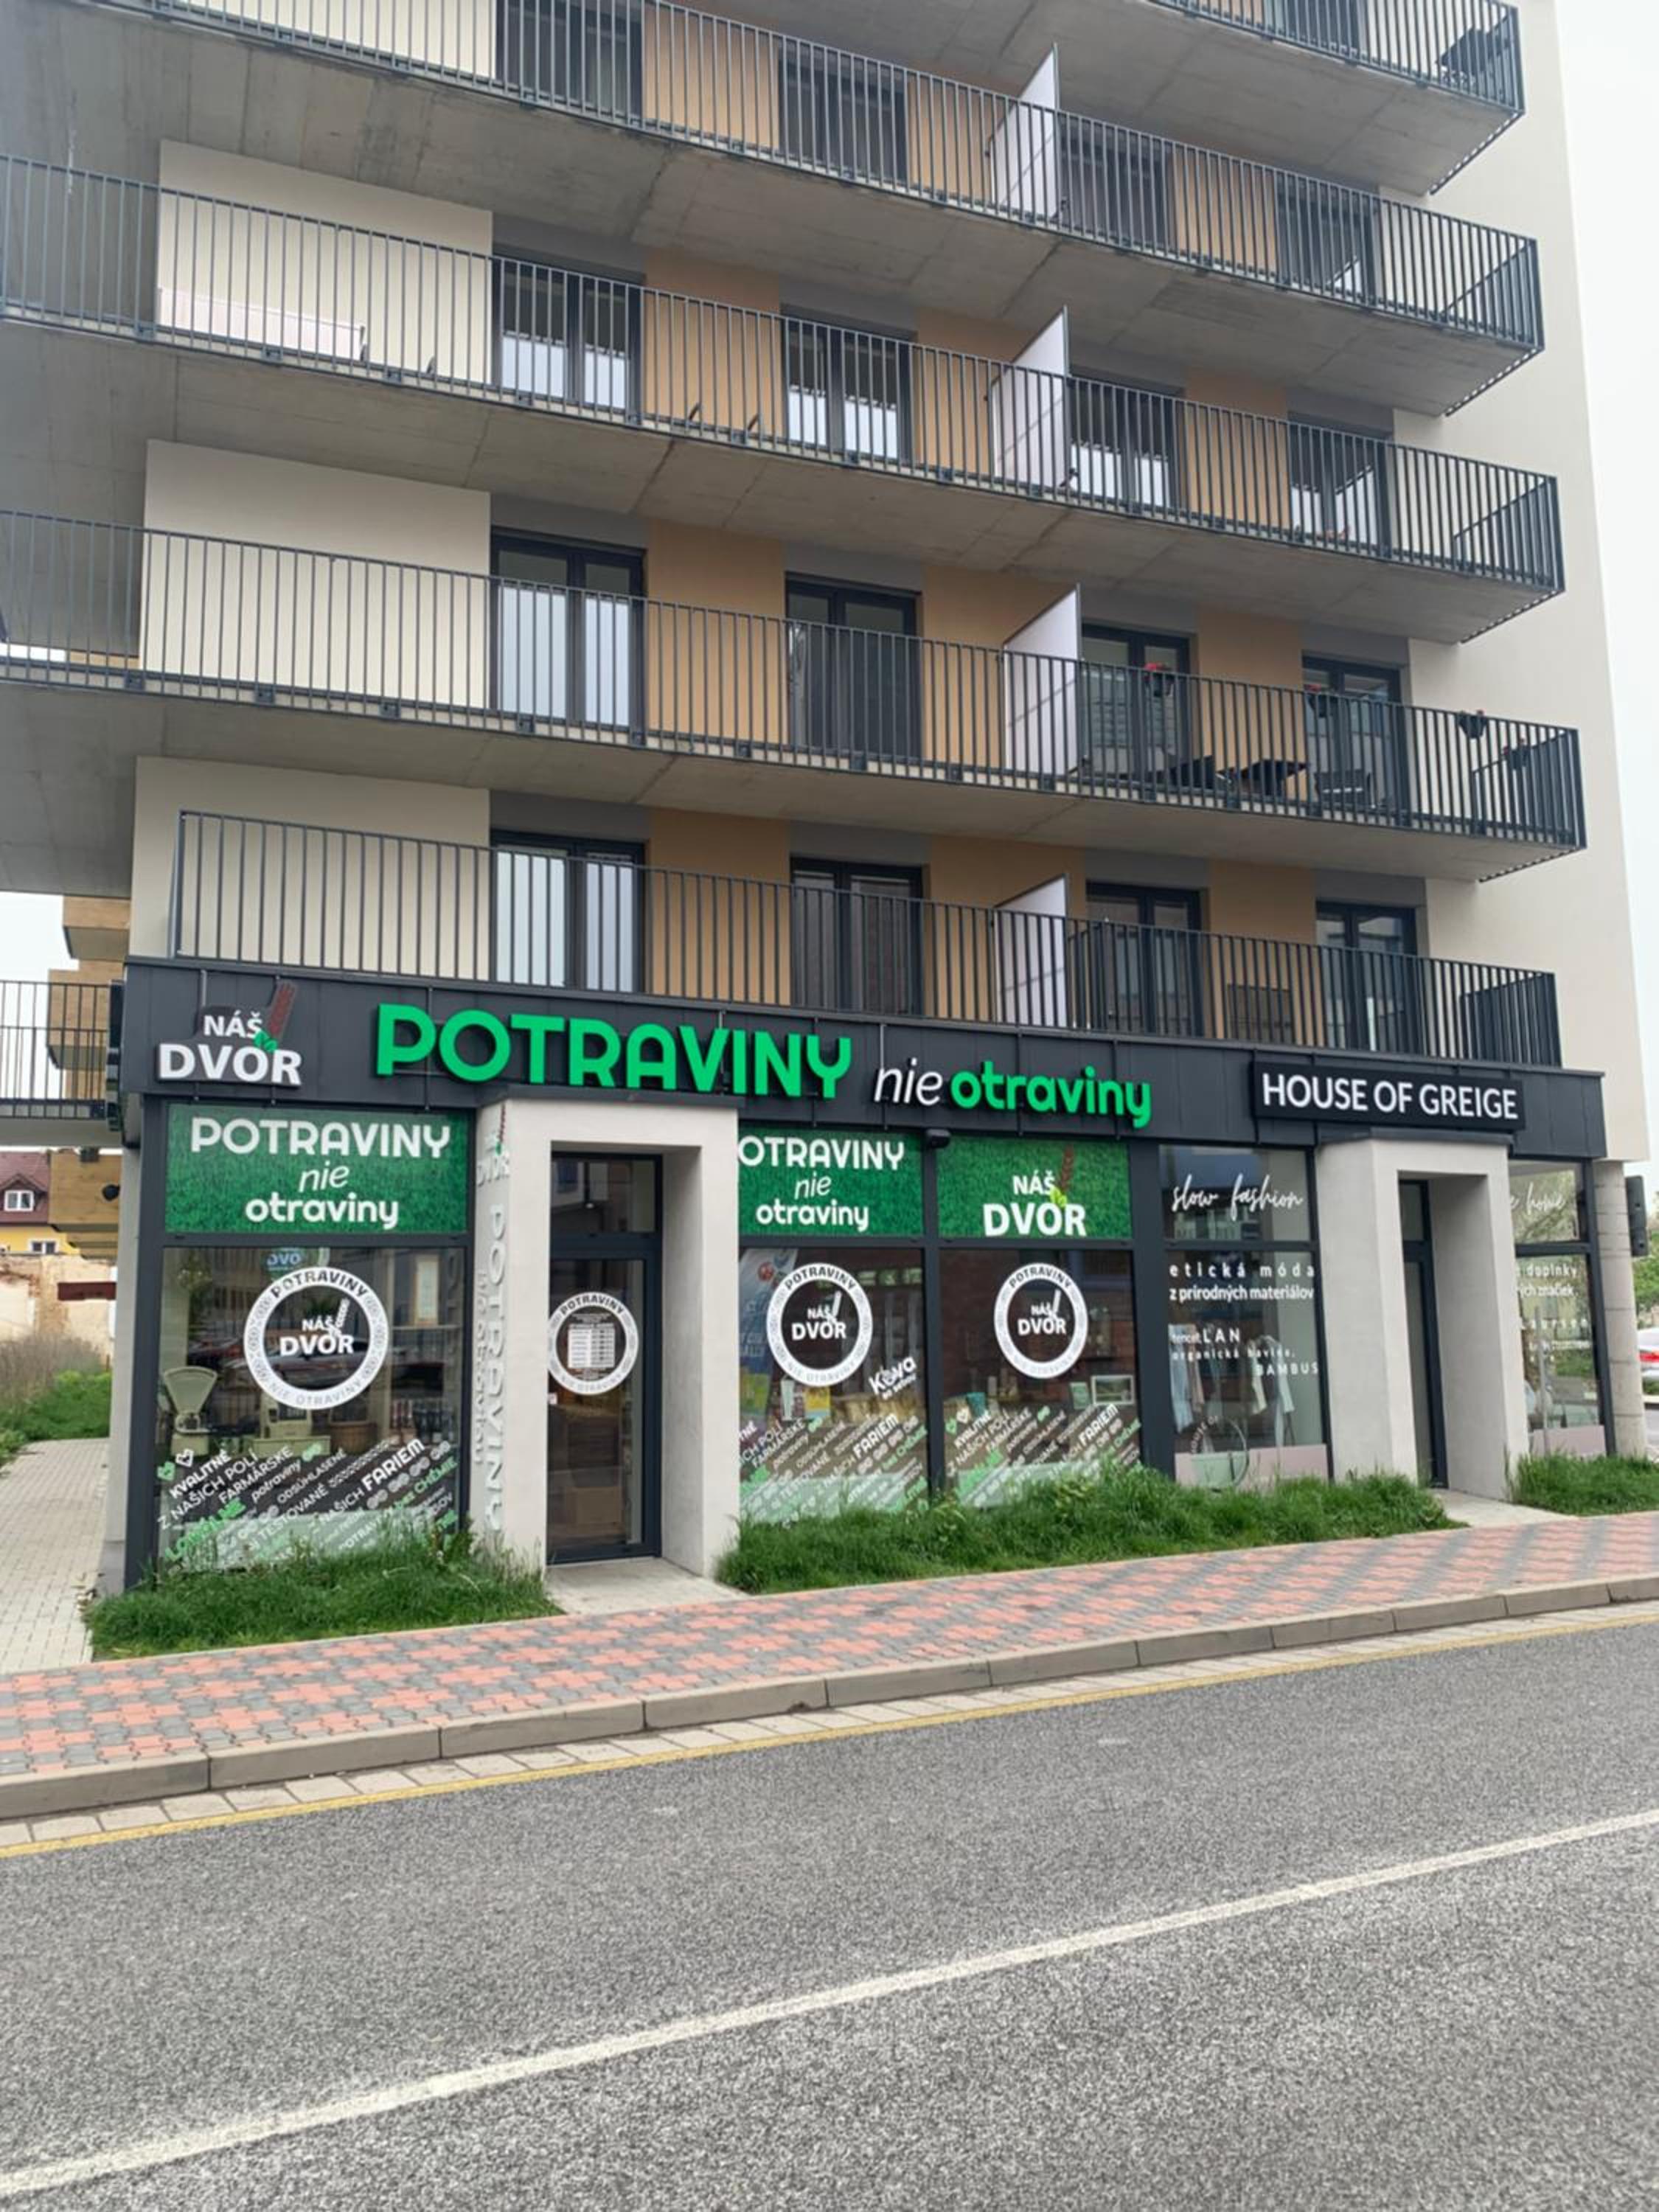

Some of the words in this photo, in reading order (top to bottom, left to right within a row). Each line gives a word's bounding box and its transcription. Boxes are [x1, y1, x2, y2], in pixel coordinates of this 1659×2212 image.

[204, 1011, 263, 1039] NÁŠ
[157, 1043, 302, 1085] DVOR
[375, 1002, 853, 1099] POTRAVINY
[874, 1057, 944, 1106] nie
[950, 1060, 1152, 1129] otraviny
[1262, 1073, 1368, 1112] HOUSE
[1373, 1081, 1413, 1113] OF
[1419, 1085, 1520, 1120] GREIGE
[190, 1116, 452, 1160] POTRAVINY
[737, 1135, 905, 1171] OTRAVINY
[298, 1160, 350, 1194] nie
[793, 1170, 832, 1202] nie
[1013, 1169, 1056, 1194] NÁŠ
[245, 1192, 399, 1231] otraviny
[1171, 1174, 1219, 1212] slow
[1230, 1173, 1304, 1222] fashion
[755, 1198, 869, 1233] otraviny
[982, 1203, 1088, 1237] DVOR
[270, 1270, 369, 1298] POTRAVINY
[784, 1266, 856, 1290] POTRAVINY
[1009, 1266, 1072, 1288] POTRAVINY
[1169, 1262, 1246, 1277] etická
[1259, 1262, 1315, 1277] móda
[560, 1295, 624, 1315] POTRAVINY
[1169, 1289, 1178, 1301] z
[1179, 1284, 1248, 1304] prírodných
[1249, 1284, 1314, 1300] materiálov
[302, 1315, 333, 1332] NÁŠ
[791, 1321, 847, 1341] DVOR
[1017, 1318, 1067, 1336] DVOR
[1203, 1327, 1241, 1343] LAN
[279, 1335, 355, 1357] DVOR
[1256, 1361, 1319, 1375] BAMBUS
[852, 1412, 900, 1459] FARIEM
[169, 1445, 232, 1500] KVALITNÉ
[218, 1444, 293, 1505] FARMÁRSKE
[361, 1438, 425, 1492] FARIEM
[157, 1514, 172, 1530] Z
[170, 1475, 225, 1520] NAŠICH
[224, 1447, 259, 1481] POLÍ
